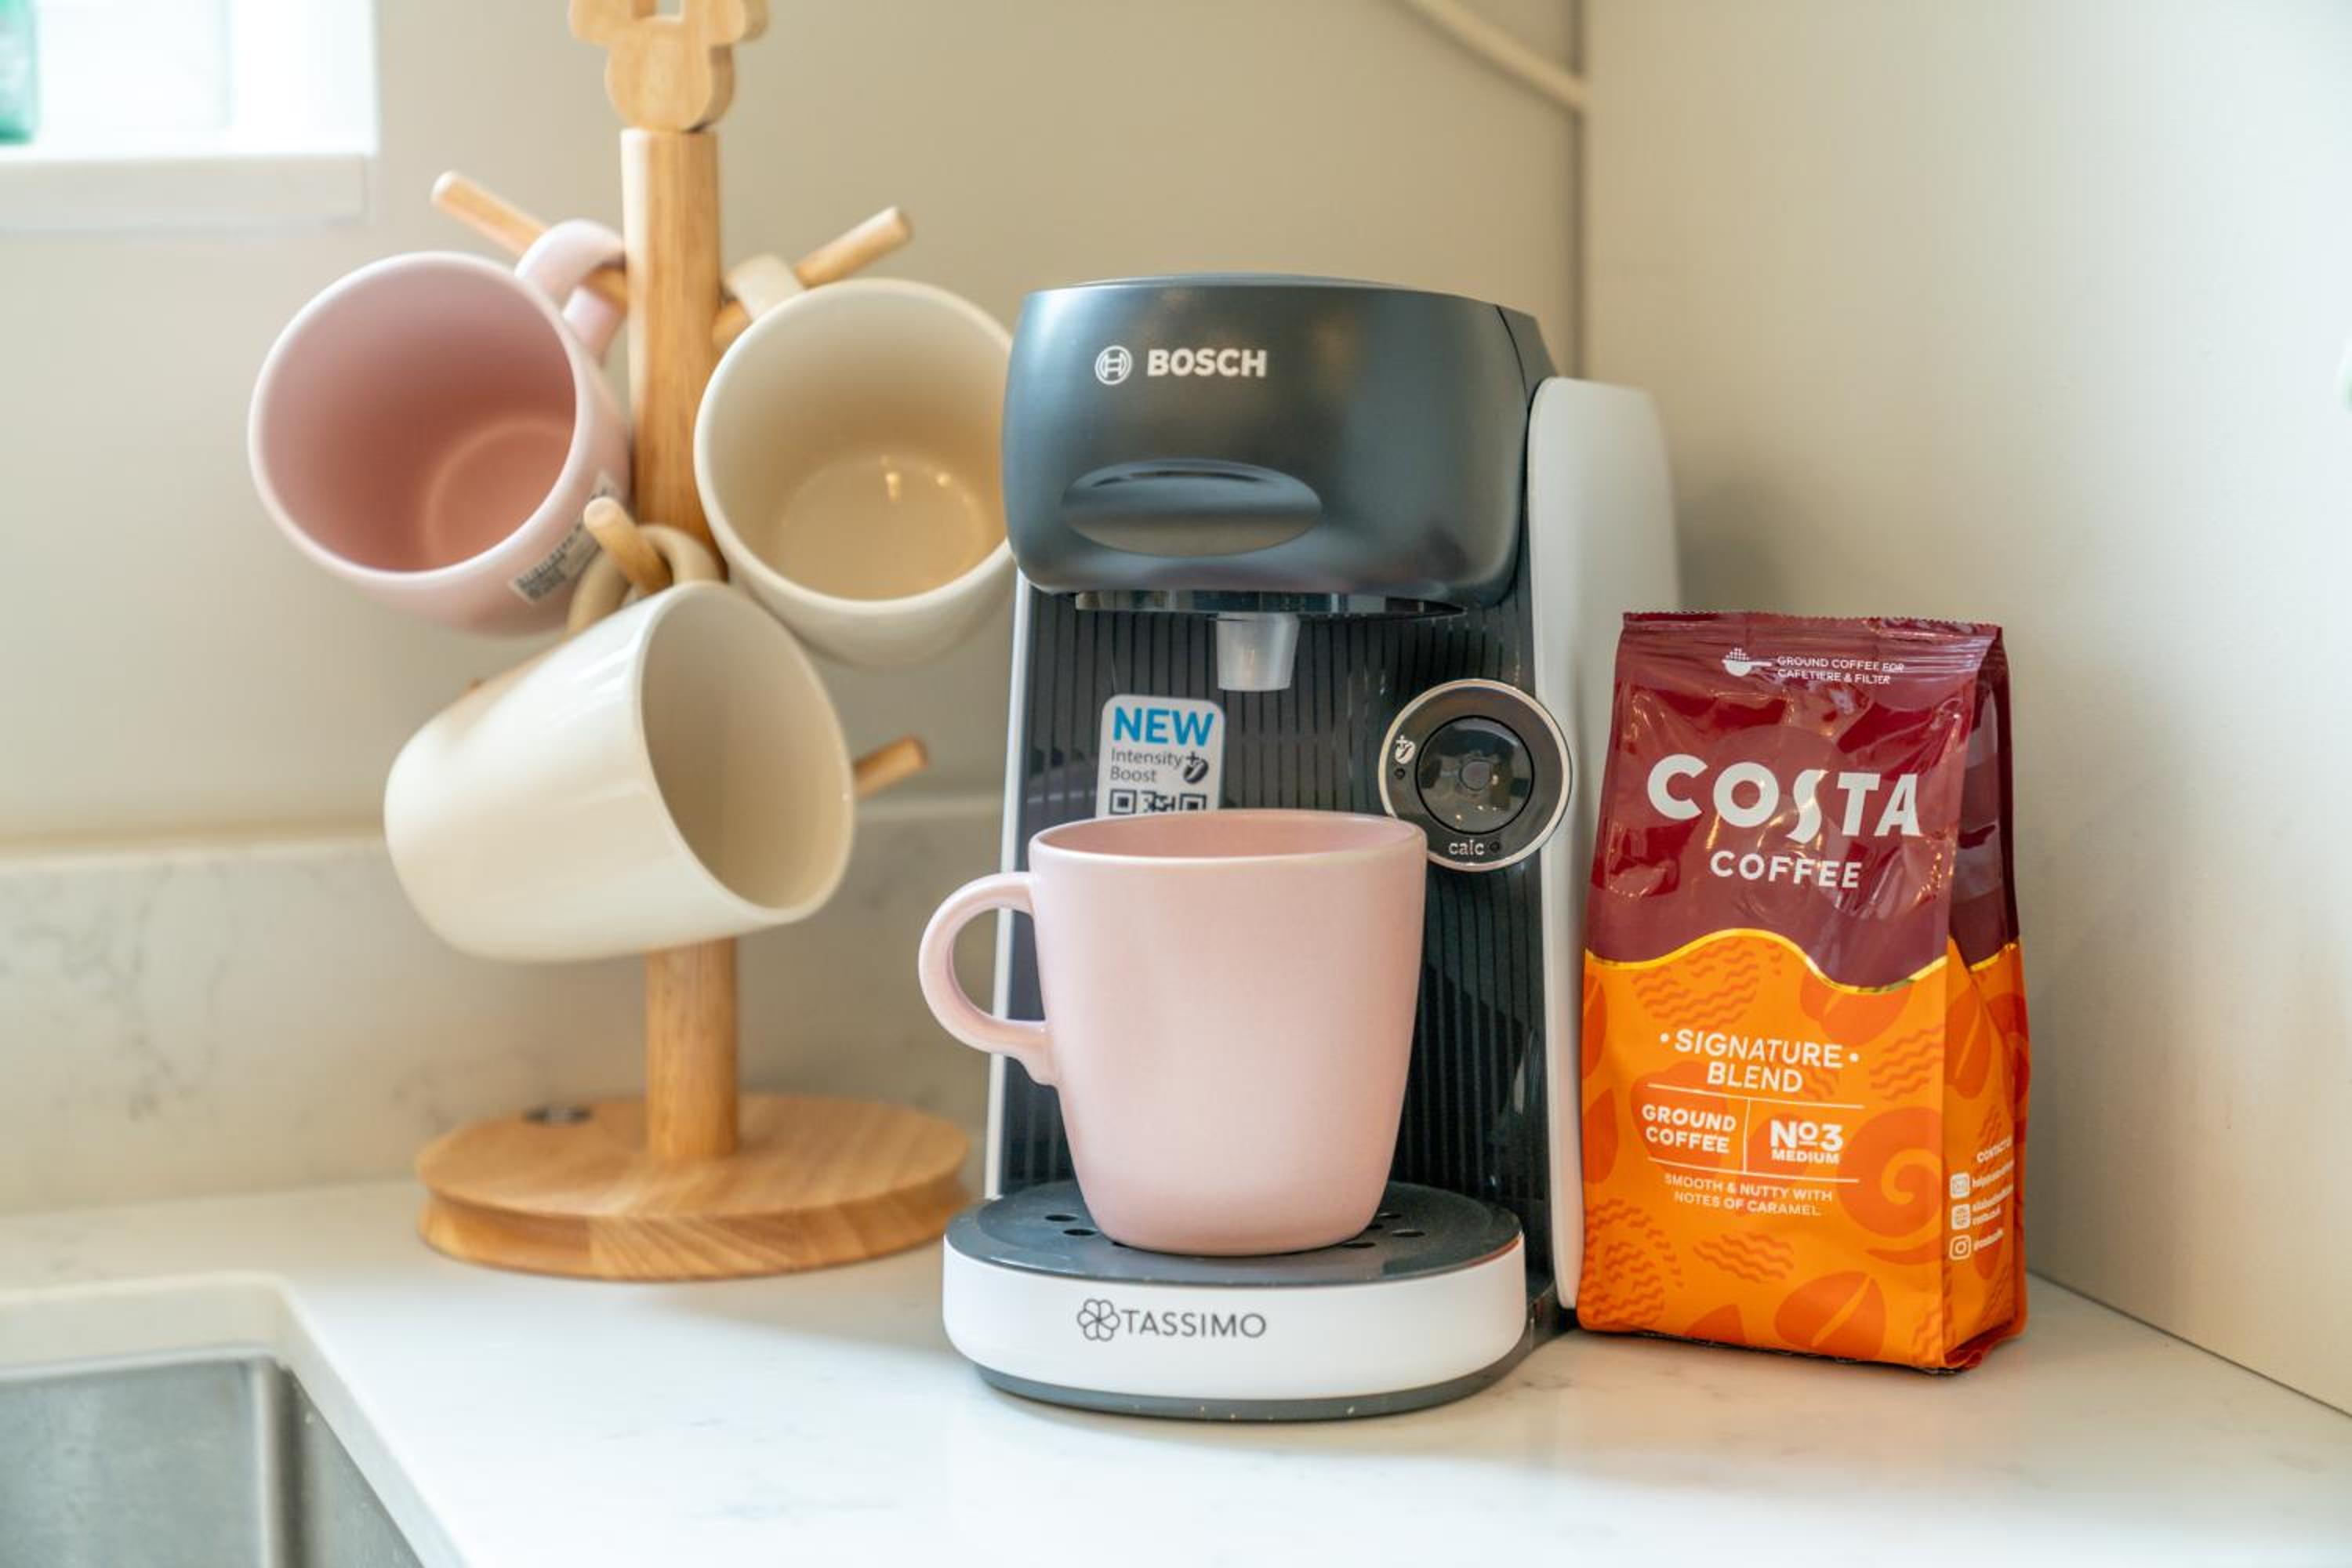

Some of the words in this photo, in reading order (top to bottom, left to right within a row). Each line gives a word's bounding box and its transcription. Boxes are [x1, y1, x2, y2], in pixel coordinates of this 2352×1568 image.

[1147, 347, 1267, 376] BOSCH
[1777, 655, 1828, 668] GROUND
[1831, 659, 1879, 670] COFFEE
[1882, 662, 1905, 673] FOR
[1842, 673, 1852, 682] &
[1854, 674, 1891, 684] FILTER
[1113, 706, 1214, 746] NEW
[1111, 749, 1184, 771] Intensity
[1109, 767, 1156, 782] Boost
[1647, 753, 1921, 843] COSTA
[1449, 840, 1484, 855] calc
[1710, 851, 1862, 889] COFFEE
[1675, 1029, 1843, 1069] SIGNATURE
[1707, 1061, 1803, 1093] BLEND
[1642, 1104, 1737, 1132] GROUND
[1646, 1127, 1730, 1153] COFFEE
[1771, 1148, 1840, 1164] MEDIUM
[1664, 1173, 1723, 1193] SMOOTH
[1727, 1179, 1737, 1193] &
[1740, 1183, 1788, 1199] NUTTY
[1793, 1188, 1832, 1202] WITH
[1674, 1191, 1720, 1207] NOTES
[1724, 1196, 1744, 1210] OF
[1747, 1200, 1821, 1217] CARAMEL
[1121, 1309, 1267, 1338] TASSIMO
